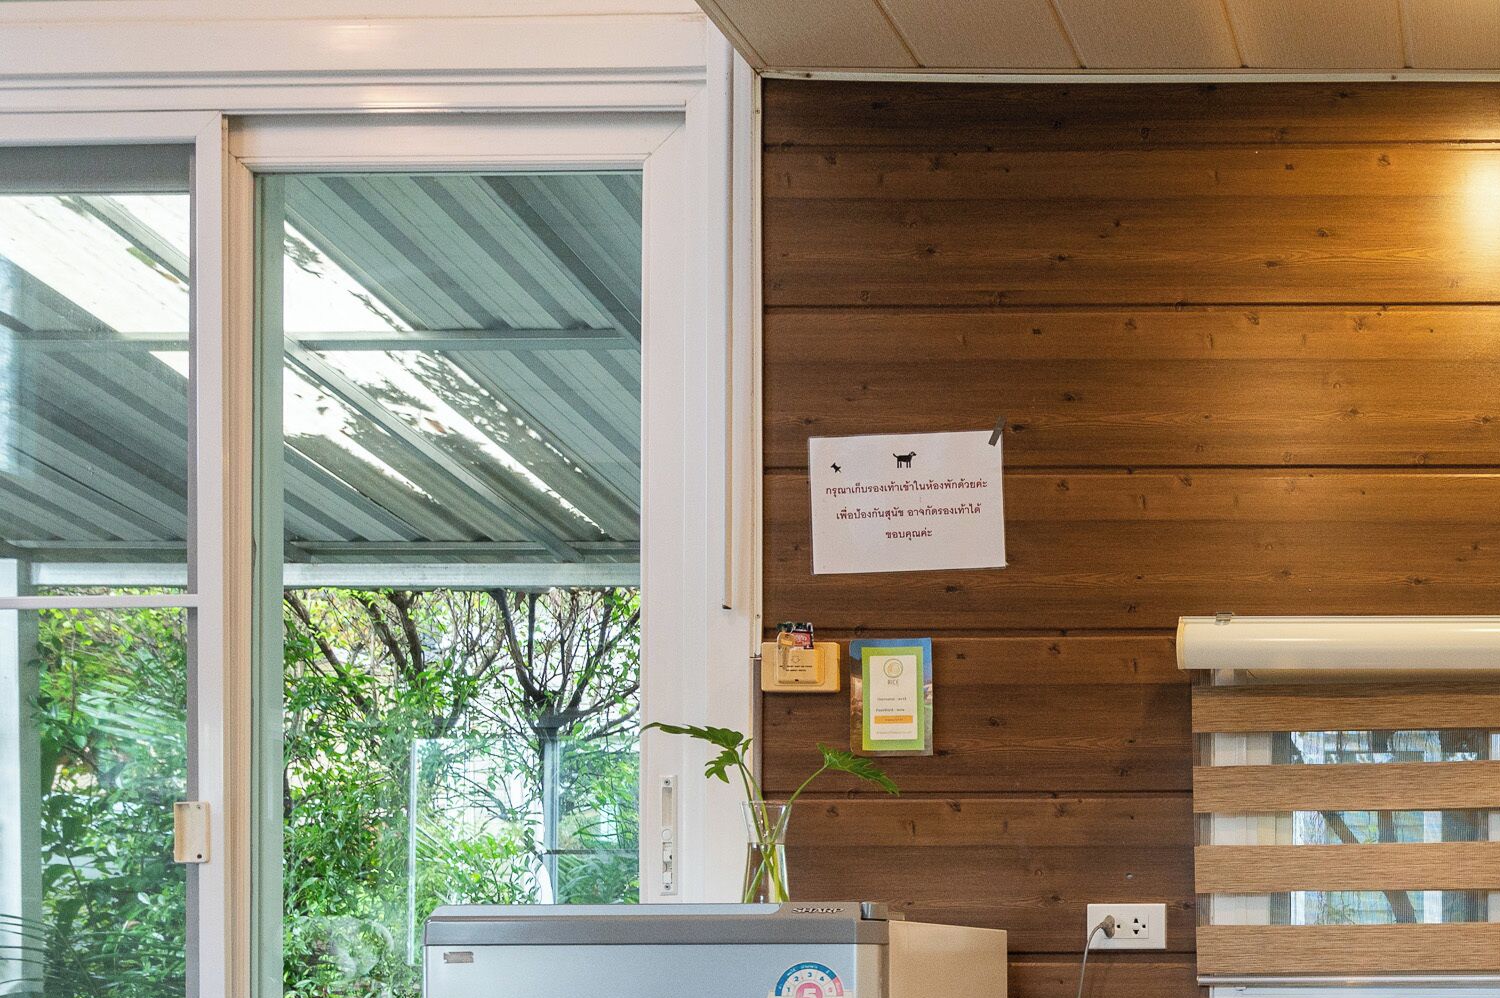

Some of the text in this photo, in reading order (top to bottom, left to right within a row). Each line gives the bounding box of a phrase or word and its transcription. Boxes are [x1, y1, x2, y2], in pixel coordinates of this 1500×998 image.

[825, 478, 988, 498] กรุณาเก็บรองเท้าเข้าในห้องพักด้วยค่ะ
[908, 503, 981, 517] อาจกัดรองเท้าได้
[885, 527, 933, 542] ขอบคุณค่ะ
